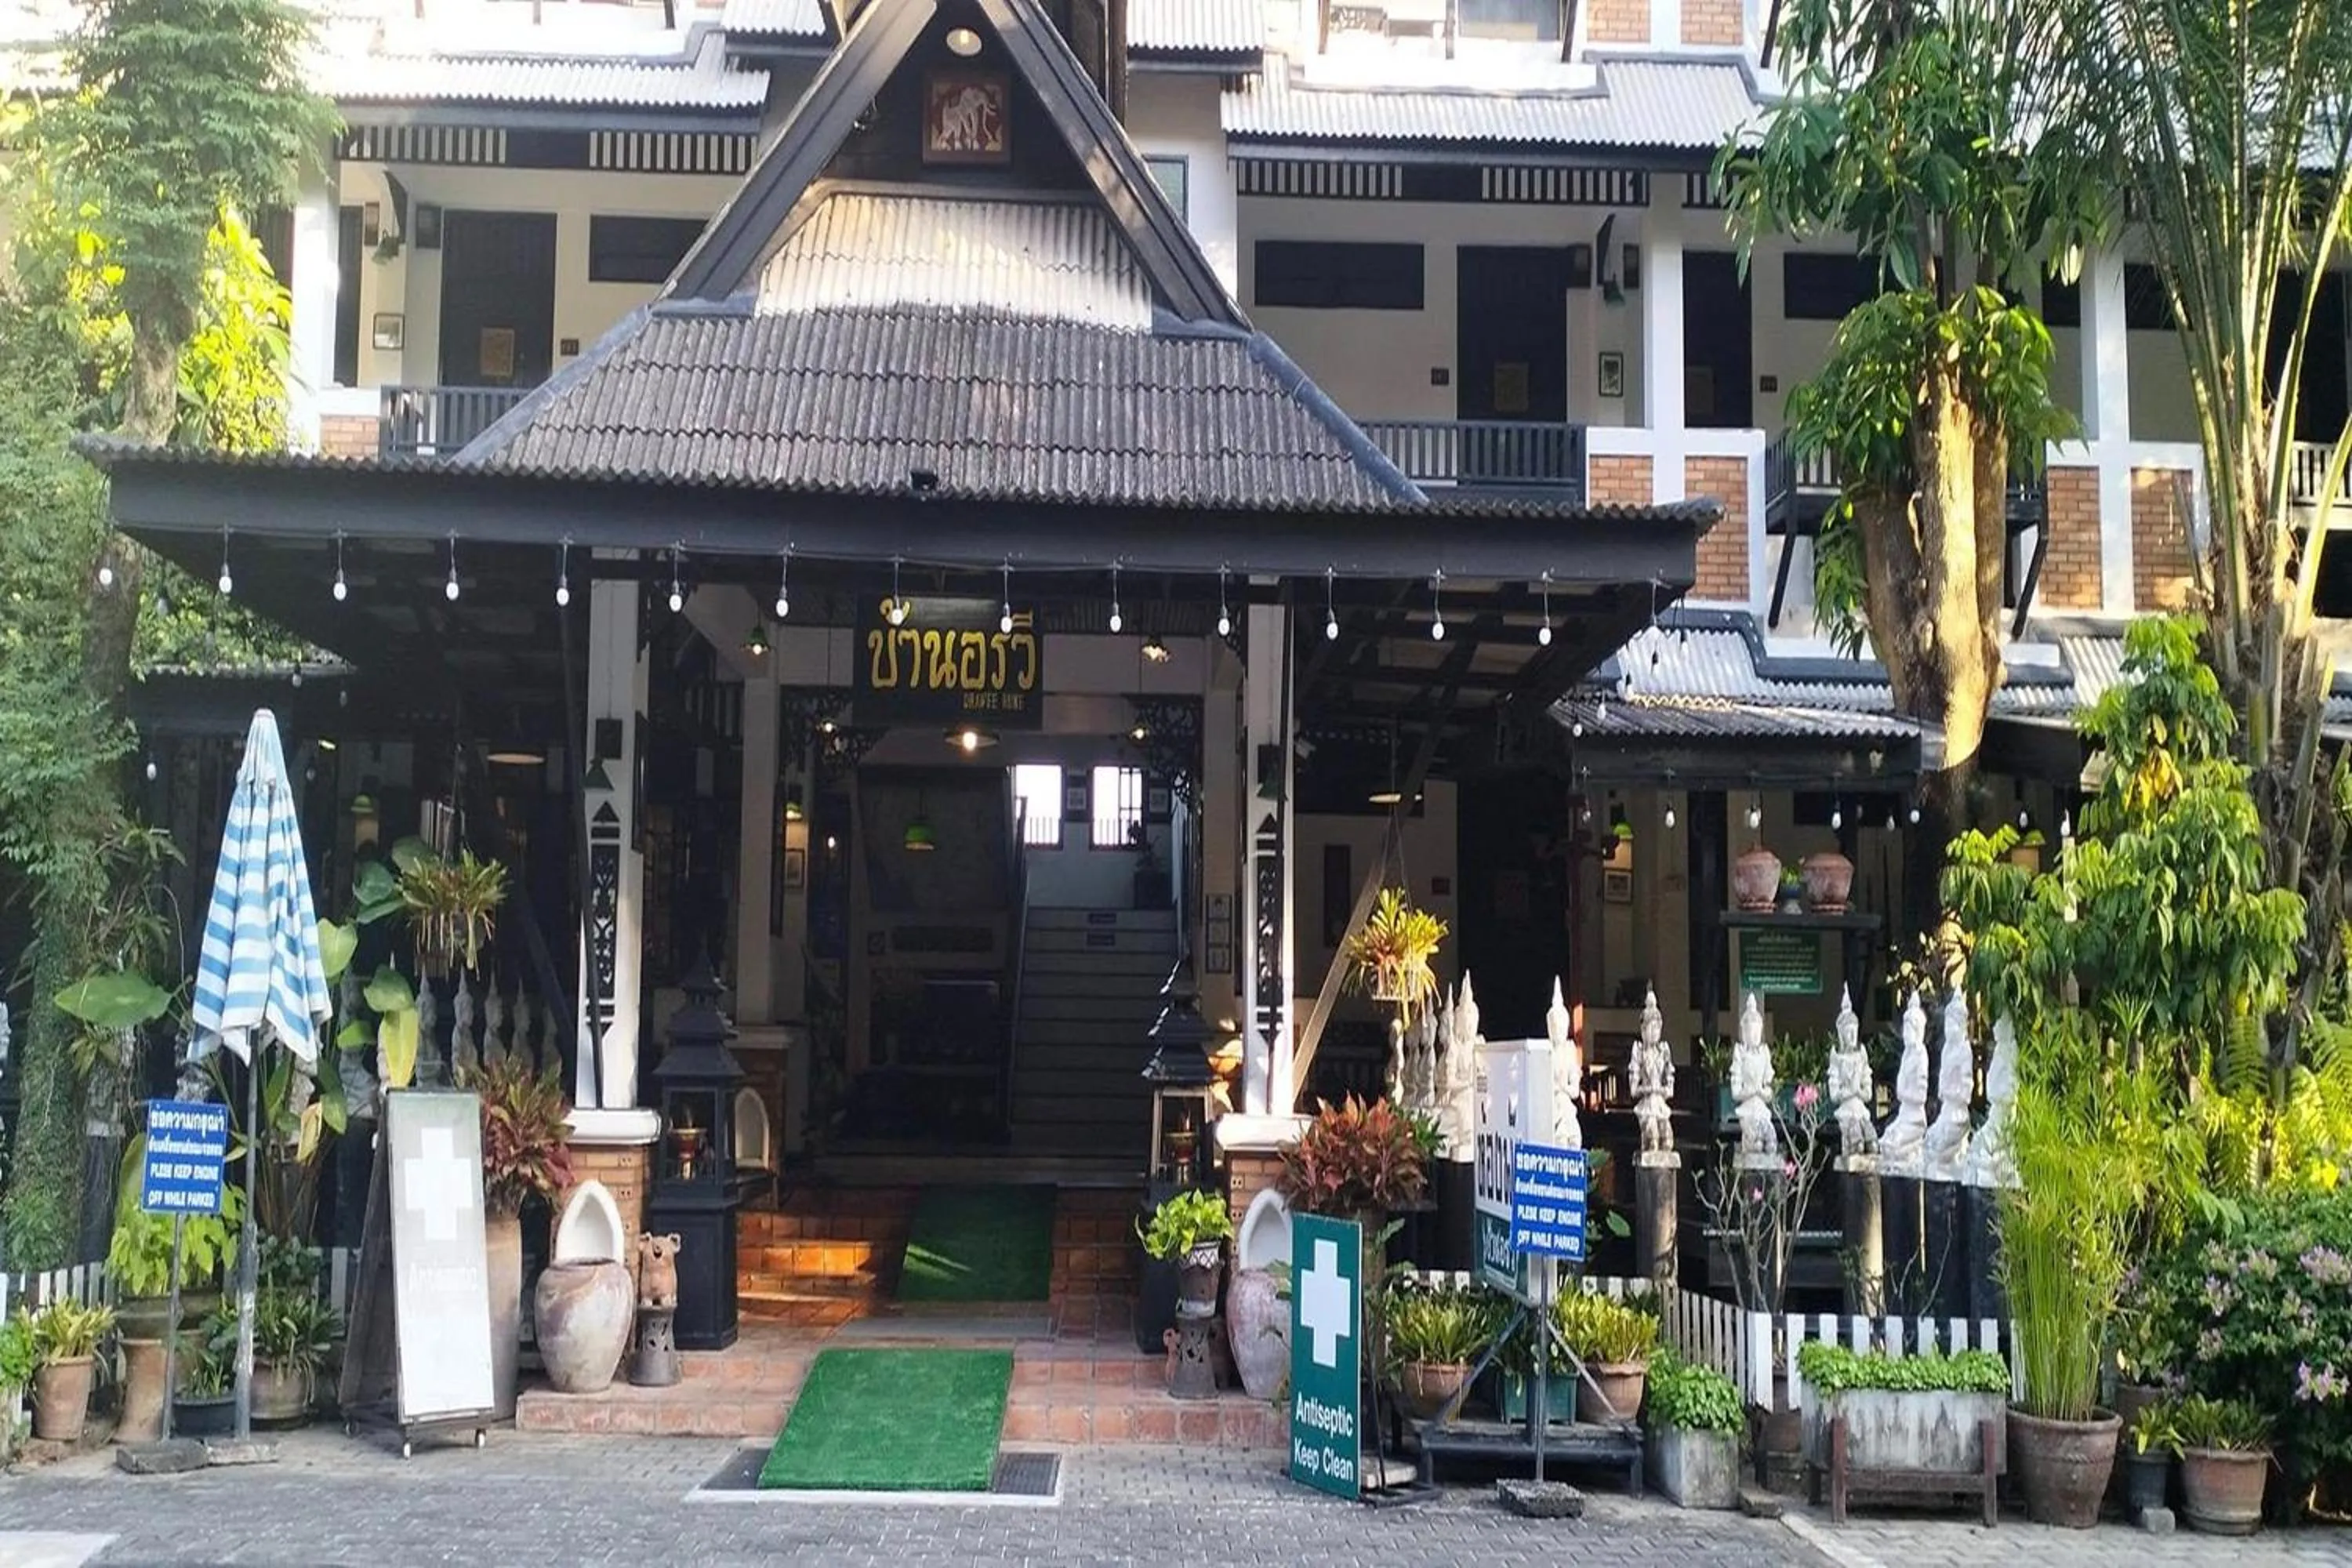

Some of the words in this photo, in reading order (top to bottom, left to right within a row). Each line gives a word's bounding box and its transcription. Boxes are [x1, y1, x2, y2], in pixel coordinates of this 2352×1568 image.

[868, 598, 1036, 690] บ้านอรวี
[173, 1163, 192, 1179] KEEP
[148, 1190, 163, 1206] OFF
[165, 1191, 185, 1206] WHILE
[187, 1192, 215, 1207] PARKED
[1539, 1207, 1556, 1223] KEEP
[1517, 1229, 1530, 1245] OFF
[1531, 1232, 1552, 1249] WHILE
[1553, 1234, 1579, 1252] PARKED
[1295, 1390, 1353, 1439] Antiseptic
[1294, 1436, 1319, 1476] Keep
[1323, 1446, 1354, 1483] Clean
